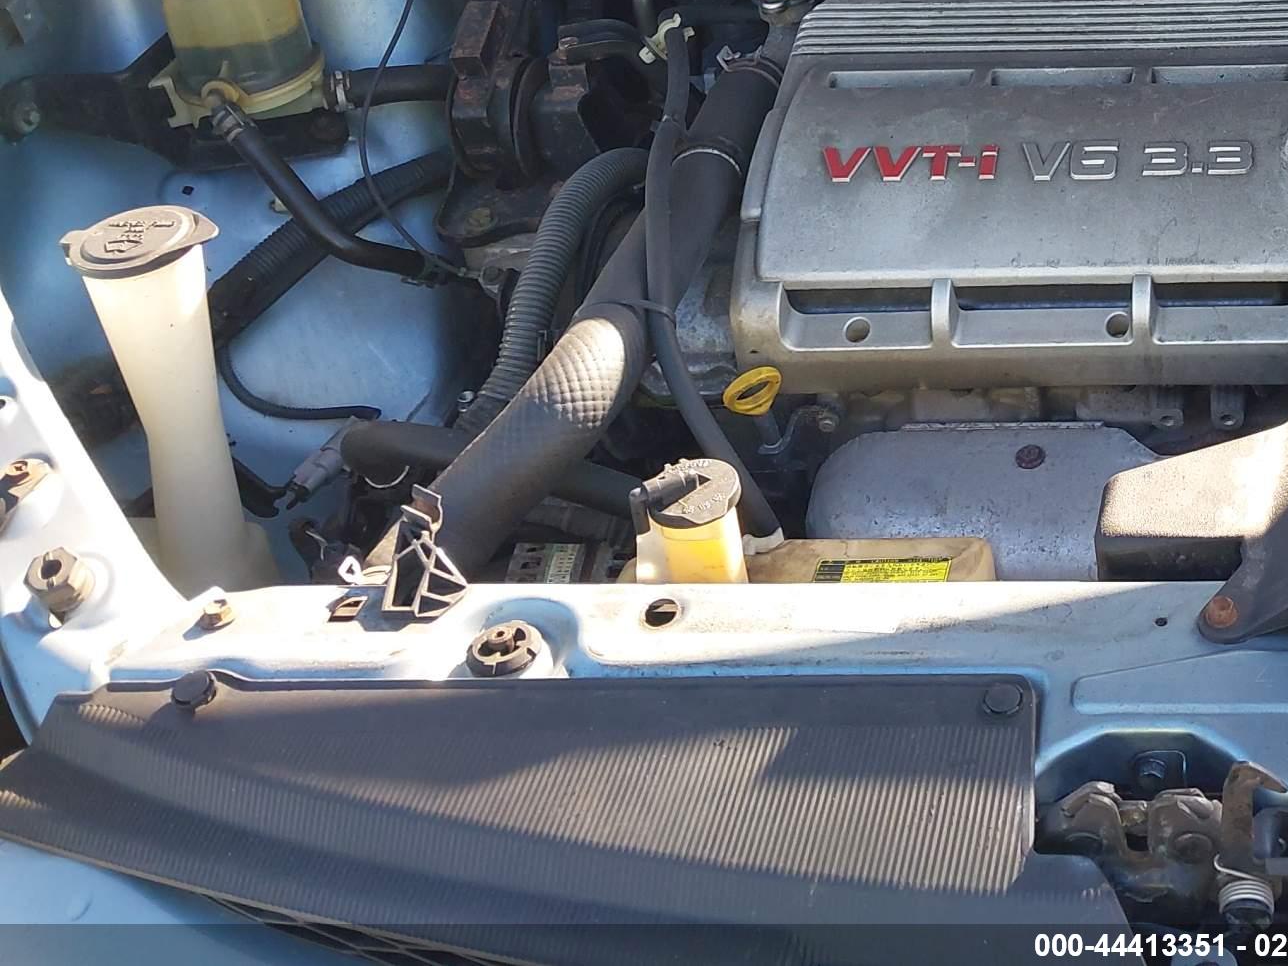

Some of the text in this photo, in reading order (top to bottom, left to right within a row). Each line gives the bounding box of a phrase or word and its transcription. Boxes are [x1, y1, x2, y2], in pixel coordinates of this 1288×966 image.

[822, 140, 1255, 182] VVT-i V6 3.3
